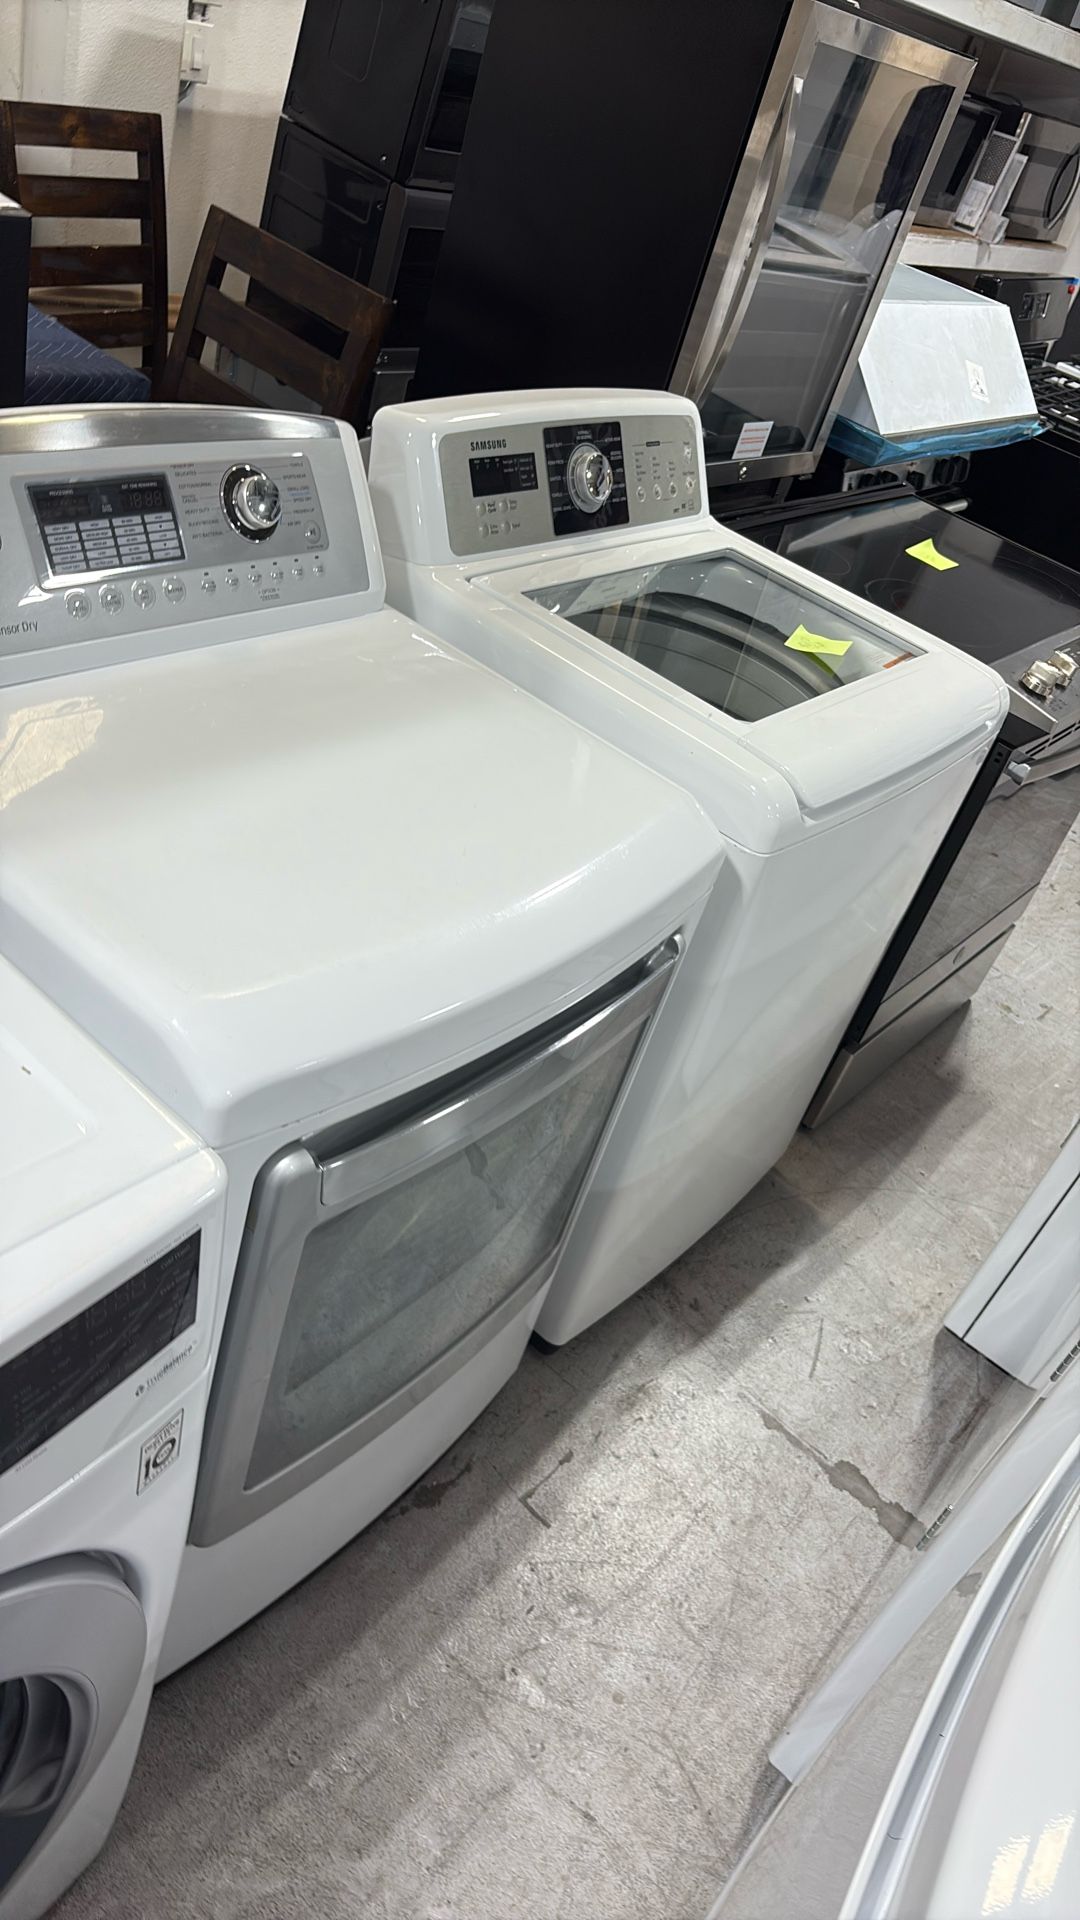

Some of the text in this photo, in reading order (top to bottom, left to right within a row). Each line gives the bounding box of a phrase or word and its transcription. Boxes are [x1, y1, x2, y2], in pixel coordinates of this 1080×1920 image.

[470, 438, 507, 452] SAMSUNG
[0, 620, 38, 636] nsor Dry
